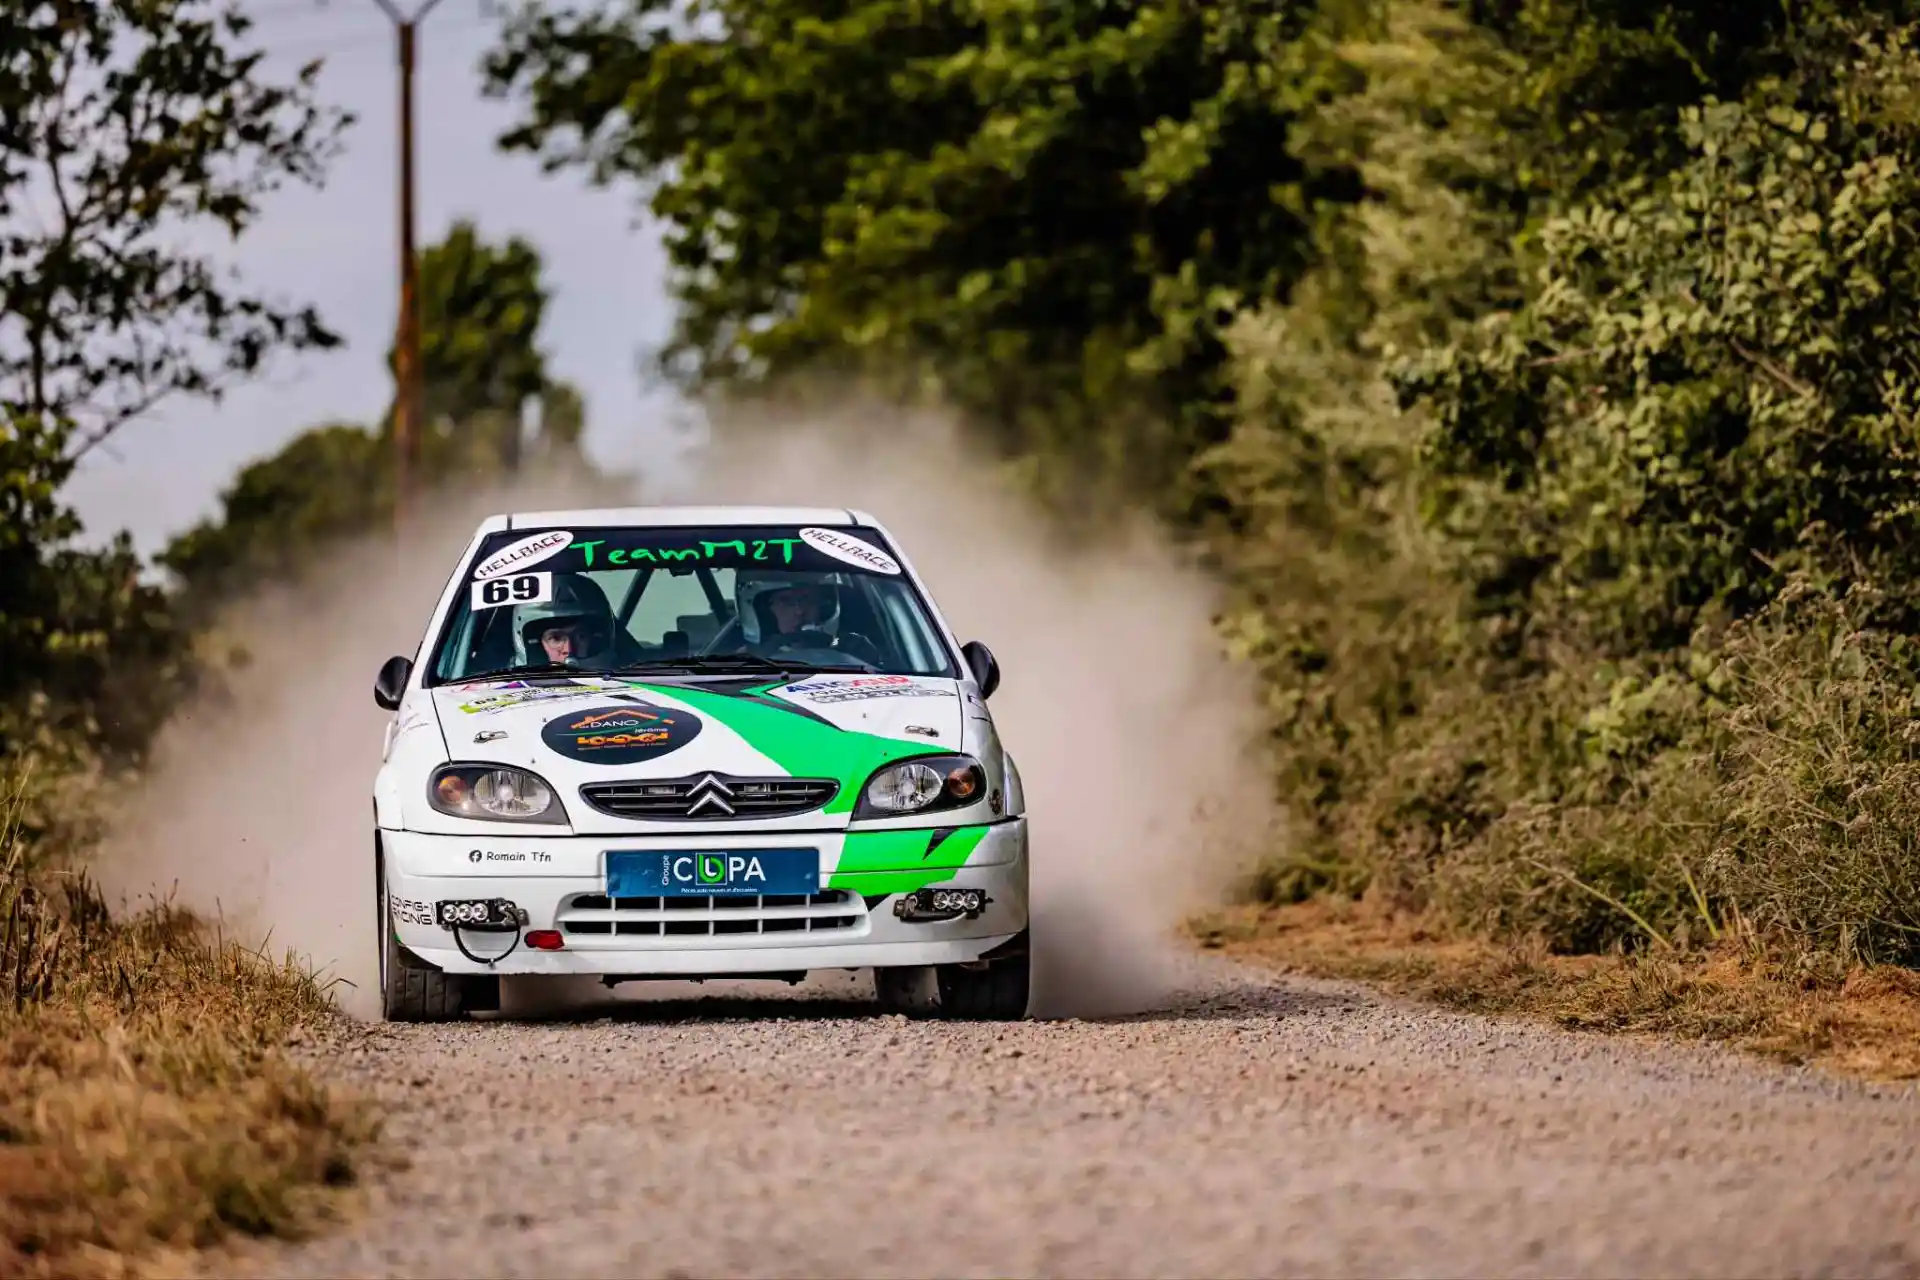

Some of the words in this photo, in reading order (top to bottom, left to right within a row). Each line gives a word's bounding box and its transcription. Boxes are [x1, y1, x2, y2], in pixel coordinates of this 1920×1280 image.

[483, 575, 540, 604] 69
[591, 719, 639, 728] DANO
[486, 851, 526, 861] Romain
[530, 851, 551, 862] Tfn
[661, 855, 670, 886] Groupe
